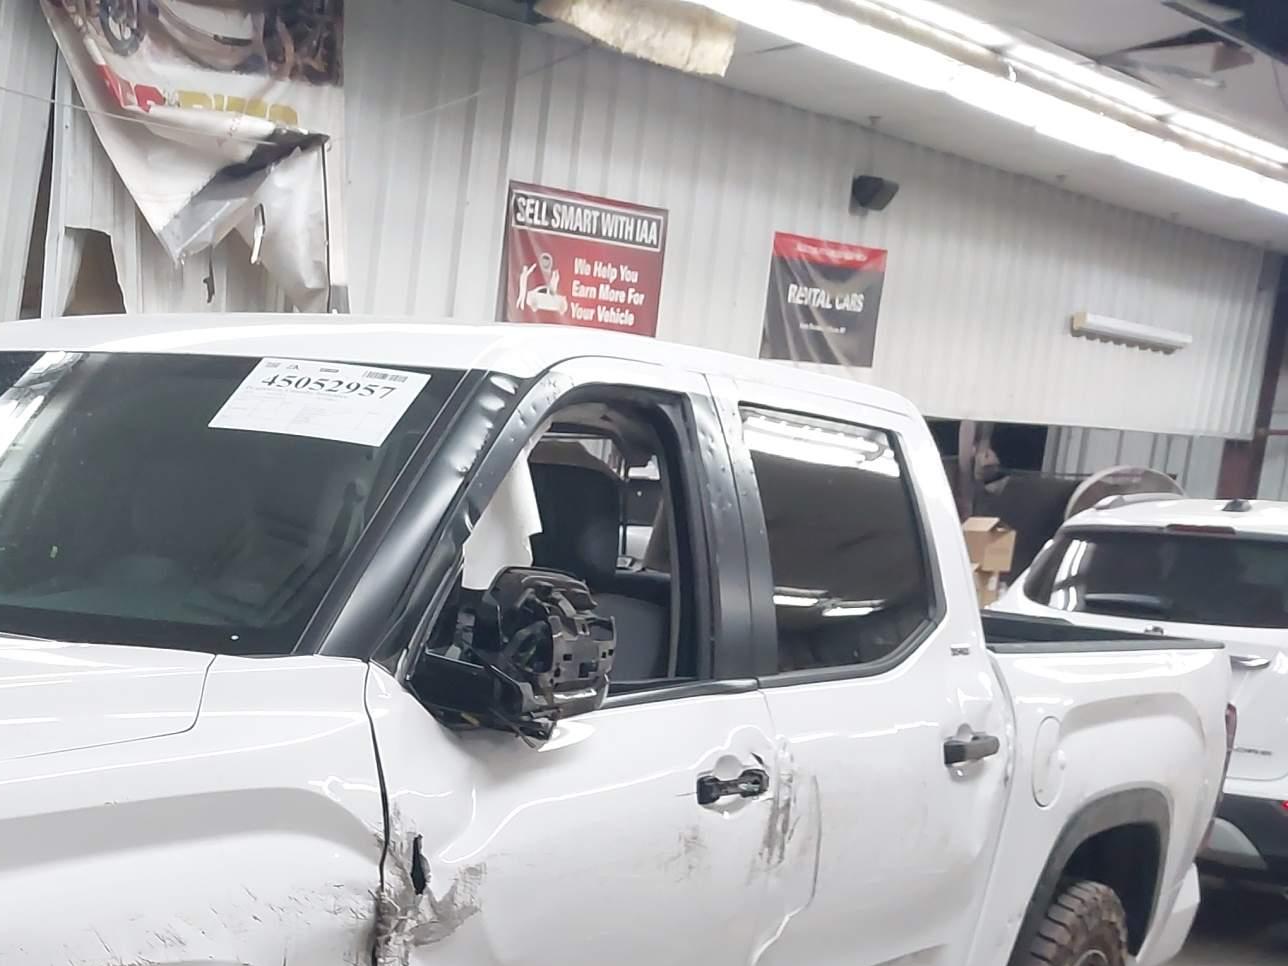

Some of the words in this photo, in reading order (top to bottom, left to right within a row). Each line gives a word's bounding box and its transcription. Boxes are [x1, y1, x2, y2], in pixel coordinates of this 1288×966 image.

[516, 196, 549, 226] SELL
[551, 203, 600, 235] SMART
[601, 211, 634, 241] WITH
[635, 219, 658, 245] IAA
[574, 257, 591, 276] We
[593, 260, 618, 284] Help
[619, 264, 639, 283] You
[571, 280, 597, 299] Earn
[598, 283, 626, 303] More
[627, 287, 645, 306] For
[787, 283, 833, 309] RENTAL
[835, 293, 865, 312] CARS
[570, 302, 595, 320] Your
[597, 304, 635, 326] Vehicle
[261, 374, 397, 400] 45052957
